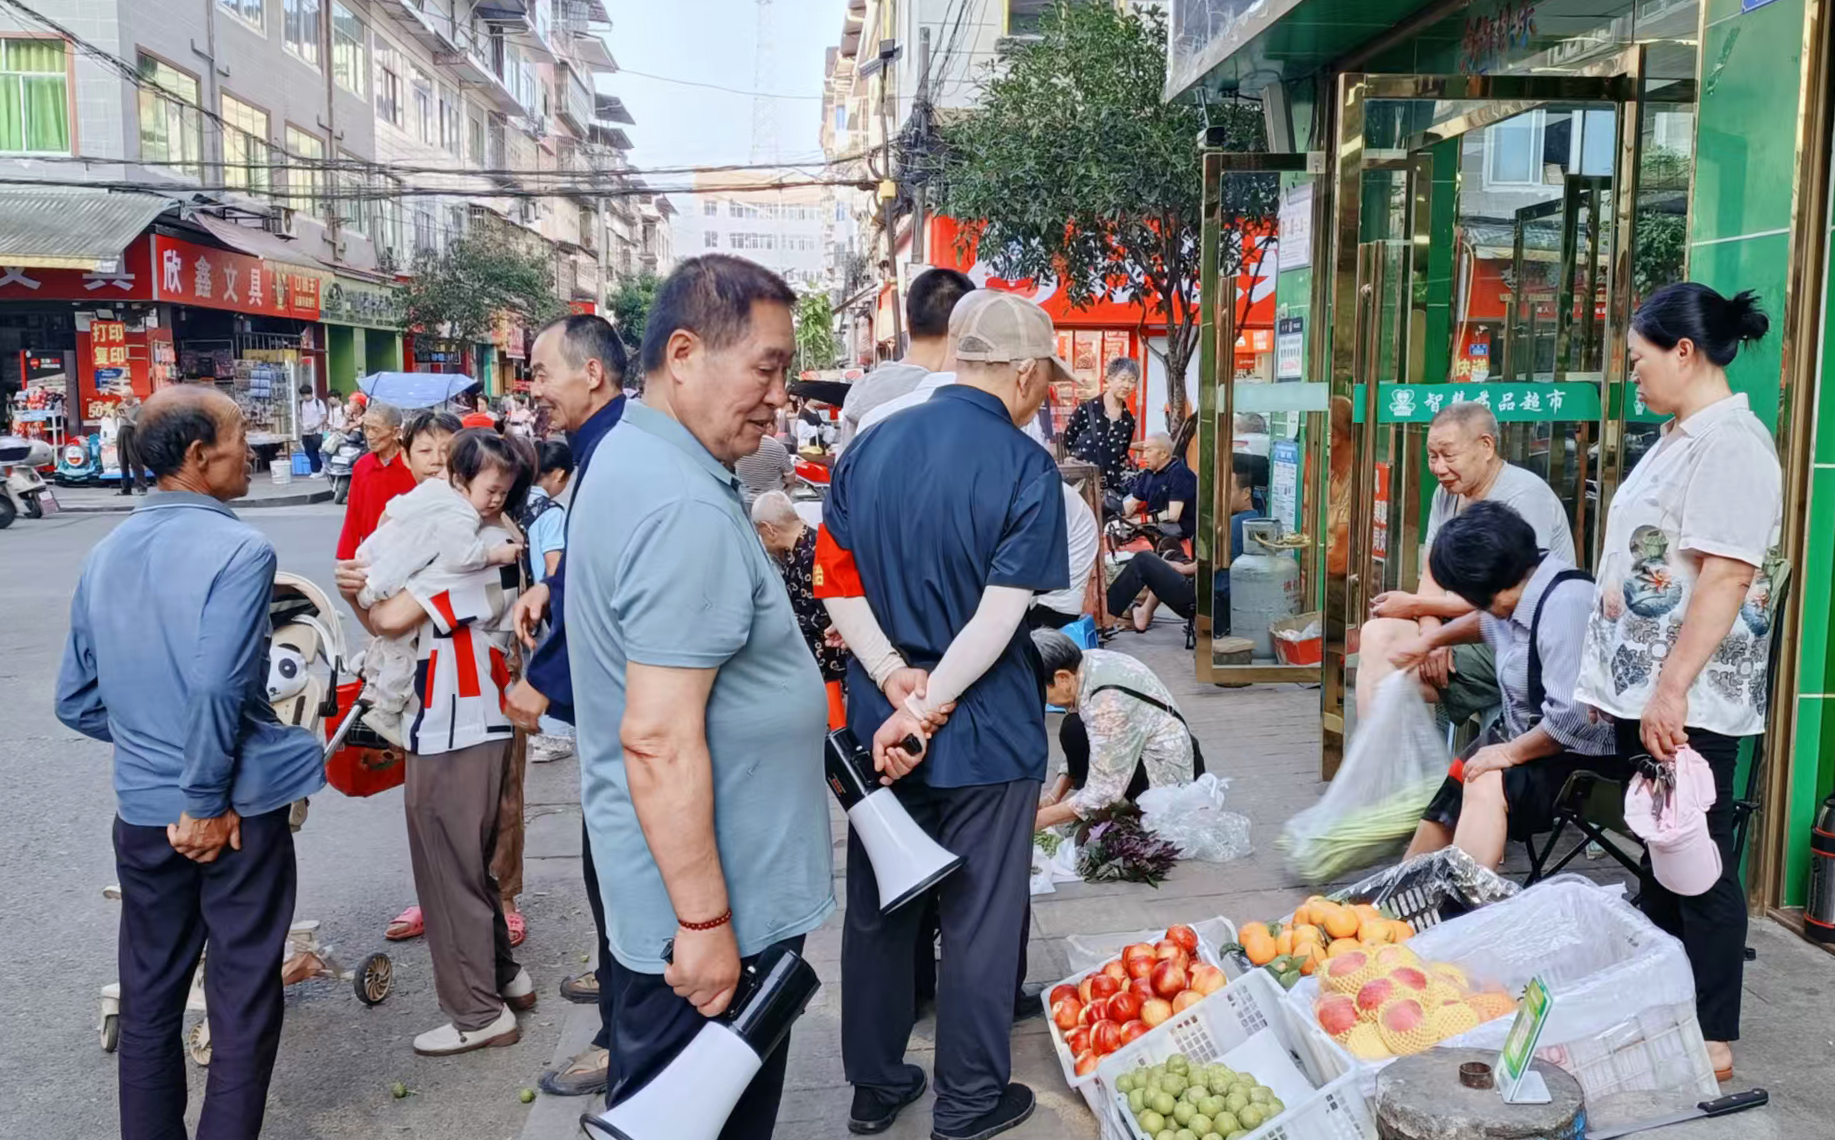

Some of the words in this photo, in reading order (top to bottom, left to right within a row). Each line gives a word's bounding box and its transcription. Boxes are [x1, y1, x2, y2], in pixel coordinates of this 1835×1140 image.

[163, 249, 263, 306] 欣鑫文具
[92, 322, 124, 343] 打印
[94, 345, 126, 367] 复印
